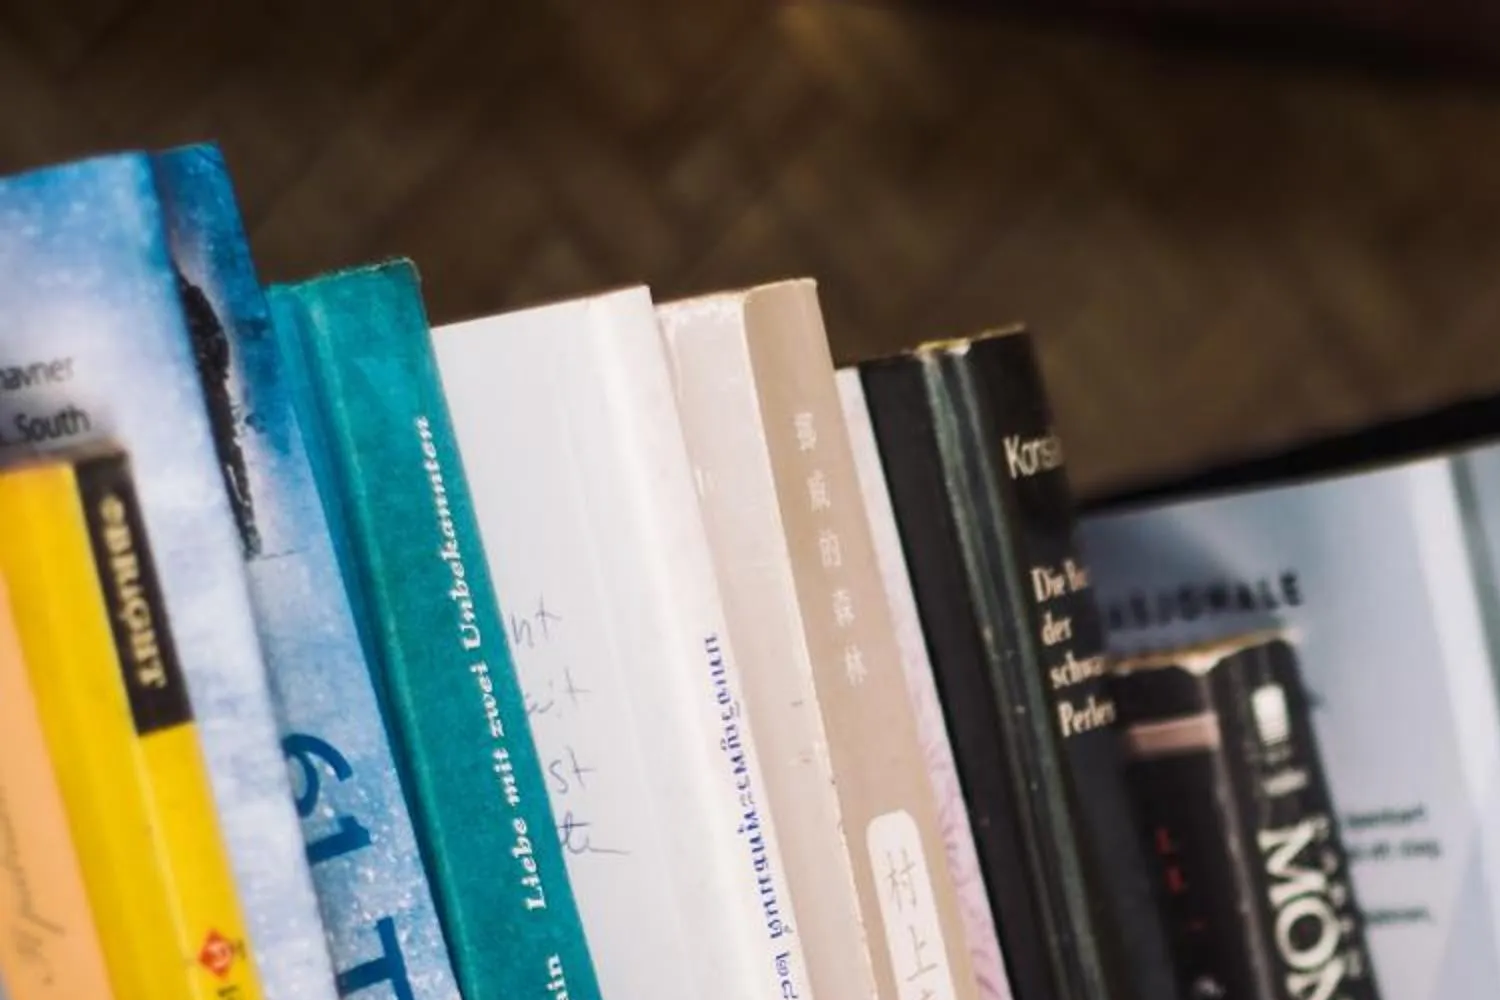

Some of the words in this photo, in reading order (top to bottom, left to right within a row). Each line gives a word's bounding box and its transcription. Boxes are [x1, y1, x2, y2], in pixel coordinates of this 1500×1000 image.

[12, 403, 92, 441] South
[413, 413, 482, 650] Unbekannten
[1030, 565, 1064, 603] Die
[1040, 610, 1073, 646] der
[471, 662, 503, 737] zwei
[281, 733, 373, 867] 61
[494, 750, 521, 807] mit
[511, 816, 547, 911] Liebe
